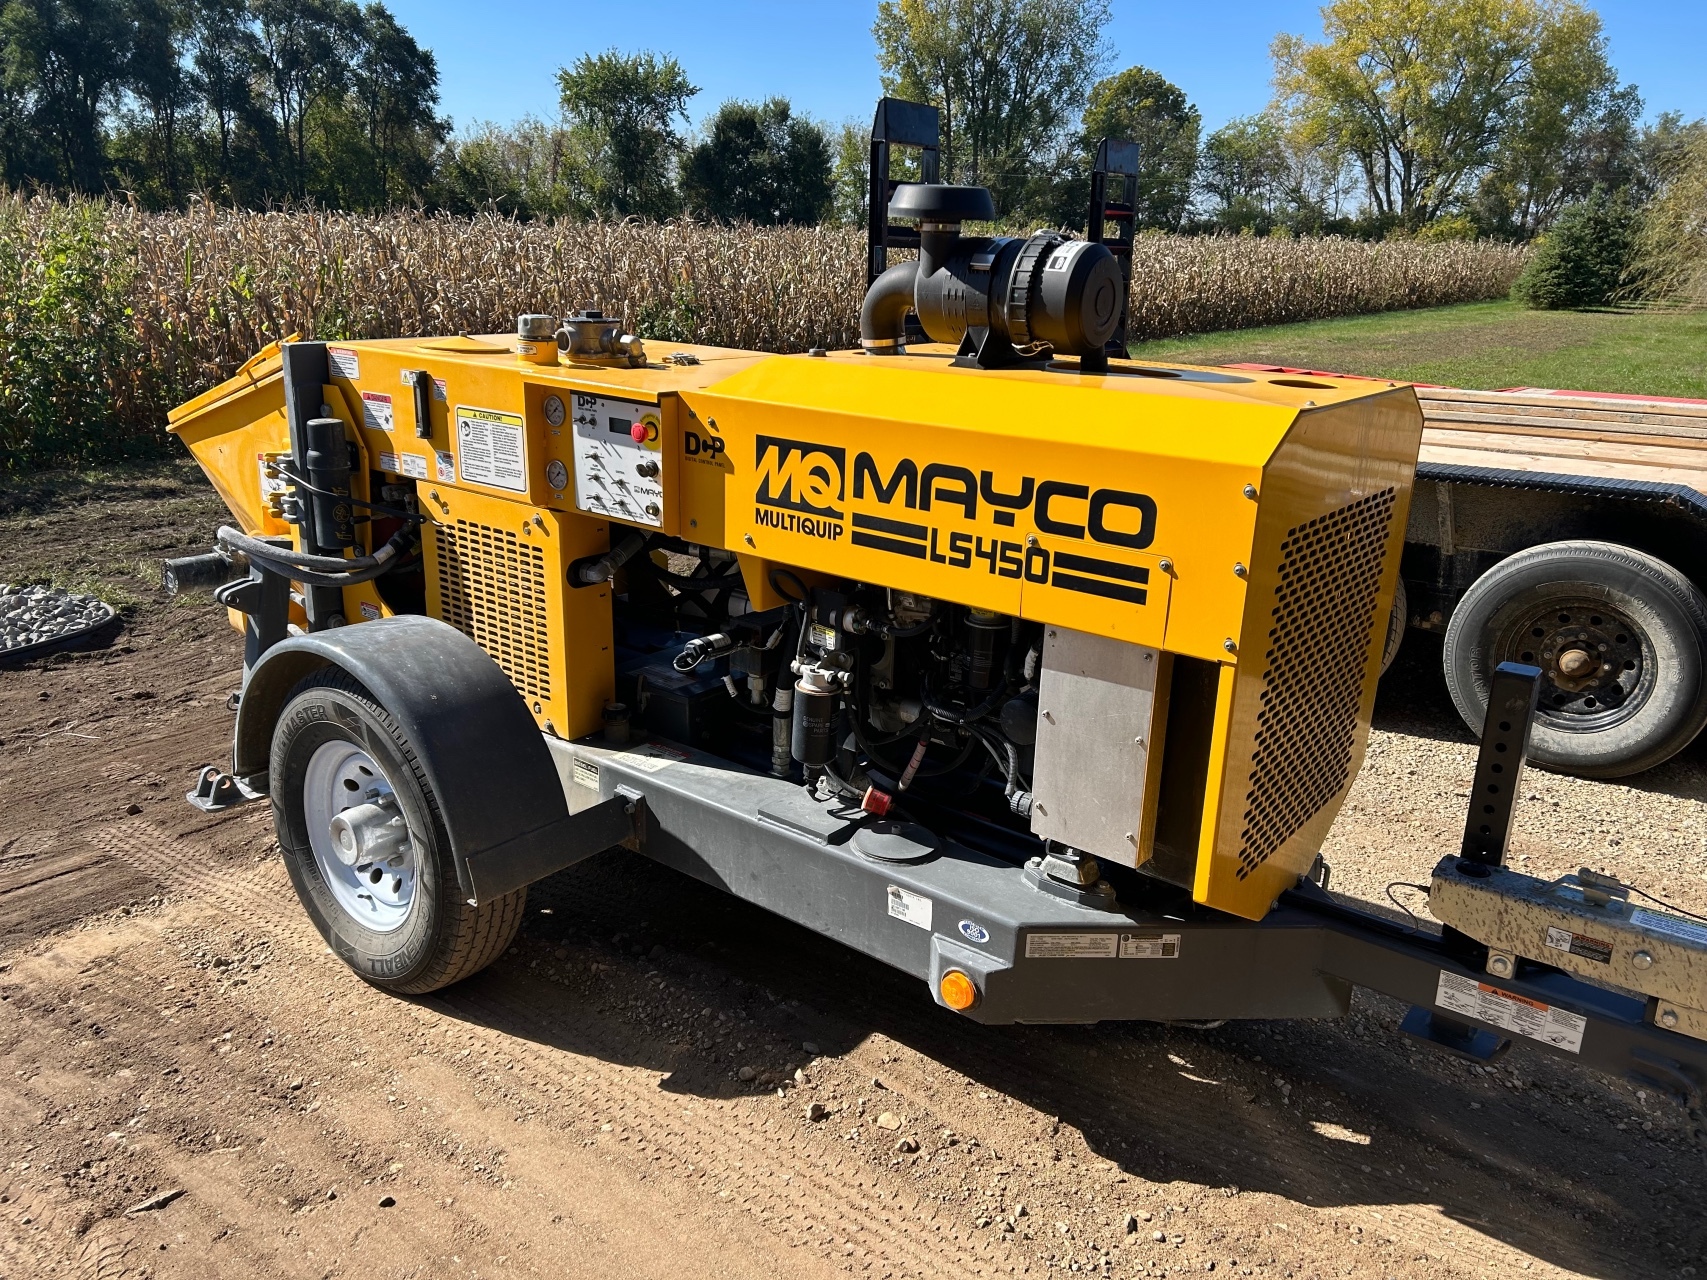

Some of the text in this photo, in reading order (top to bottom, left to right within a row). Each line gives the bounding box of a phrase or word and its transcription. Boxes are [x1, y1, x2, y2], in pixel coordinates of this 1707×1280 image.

[478, 412, 503, 422] CAUTION!
[755, 437, 845, 516] MQ
[852, 451, 1158, 550] MAYCO
[755, 507, 844, 541] MULTIQUIP
[930, 527, 1051, 585] LS450
[1501, 991, 1534, 1007] WARNING
